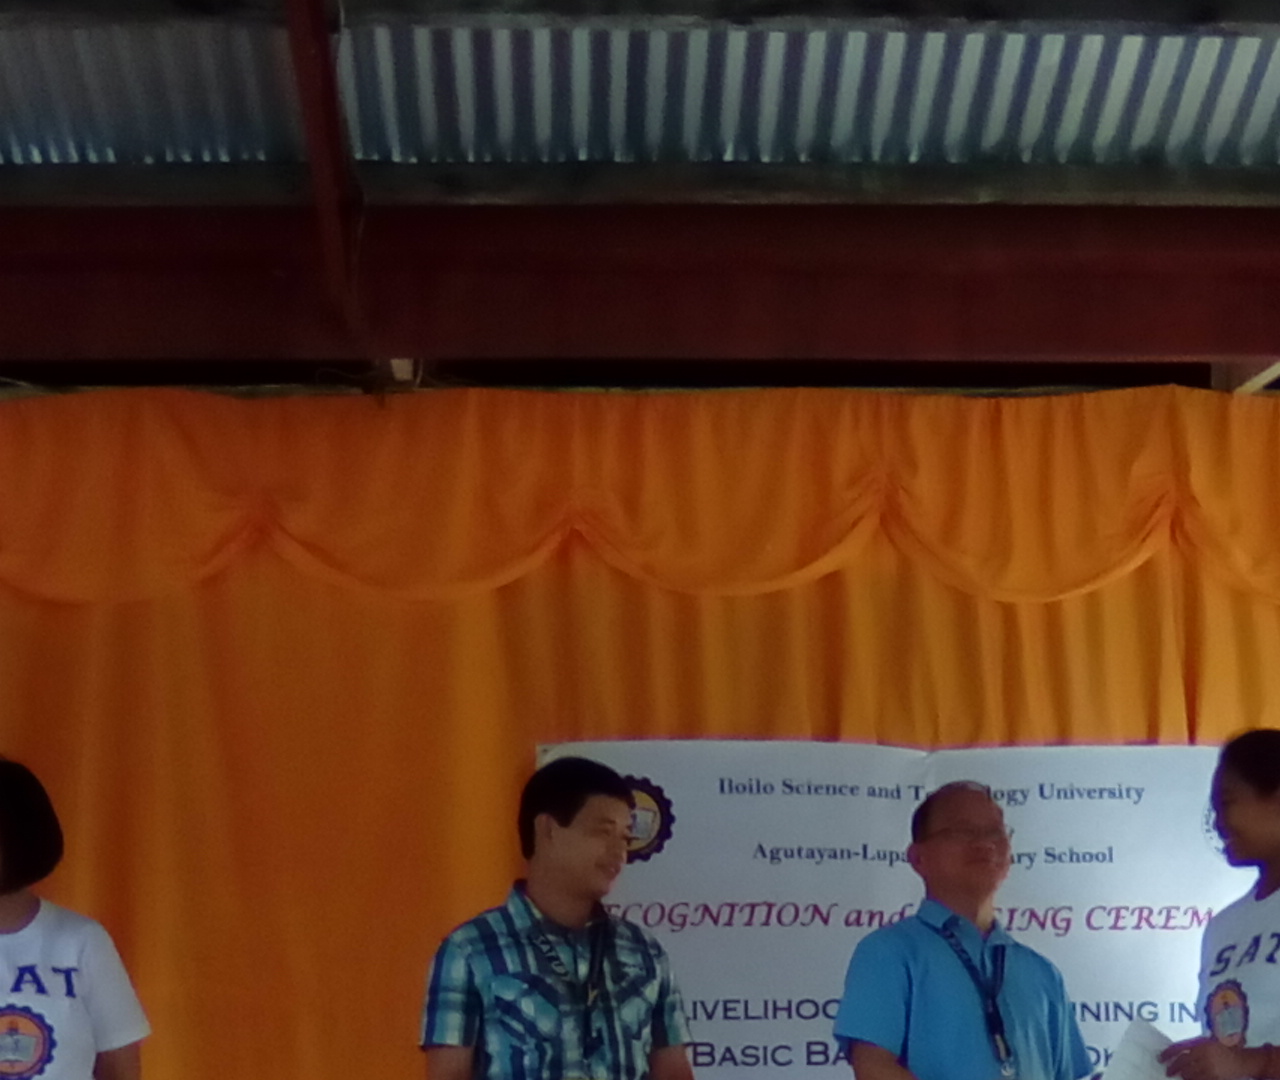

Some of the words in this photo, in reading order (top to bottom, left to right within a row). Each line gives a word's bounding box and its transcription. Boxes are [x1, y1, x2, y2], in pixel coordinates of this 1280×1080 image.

[719, 777, 775, 796] Iloilo
[781, 778, 861, 797] Science
[866, 783, 902, 801] and
[1038, 783, 1145, 805] University
[1043, 846, 1114, 864] School
[691, 1040, 793, 1067] BASIC
